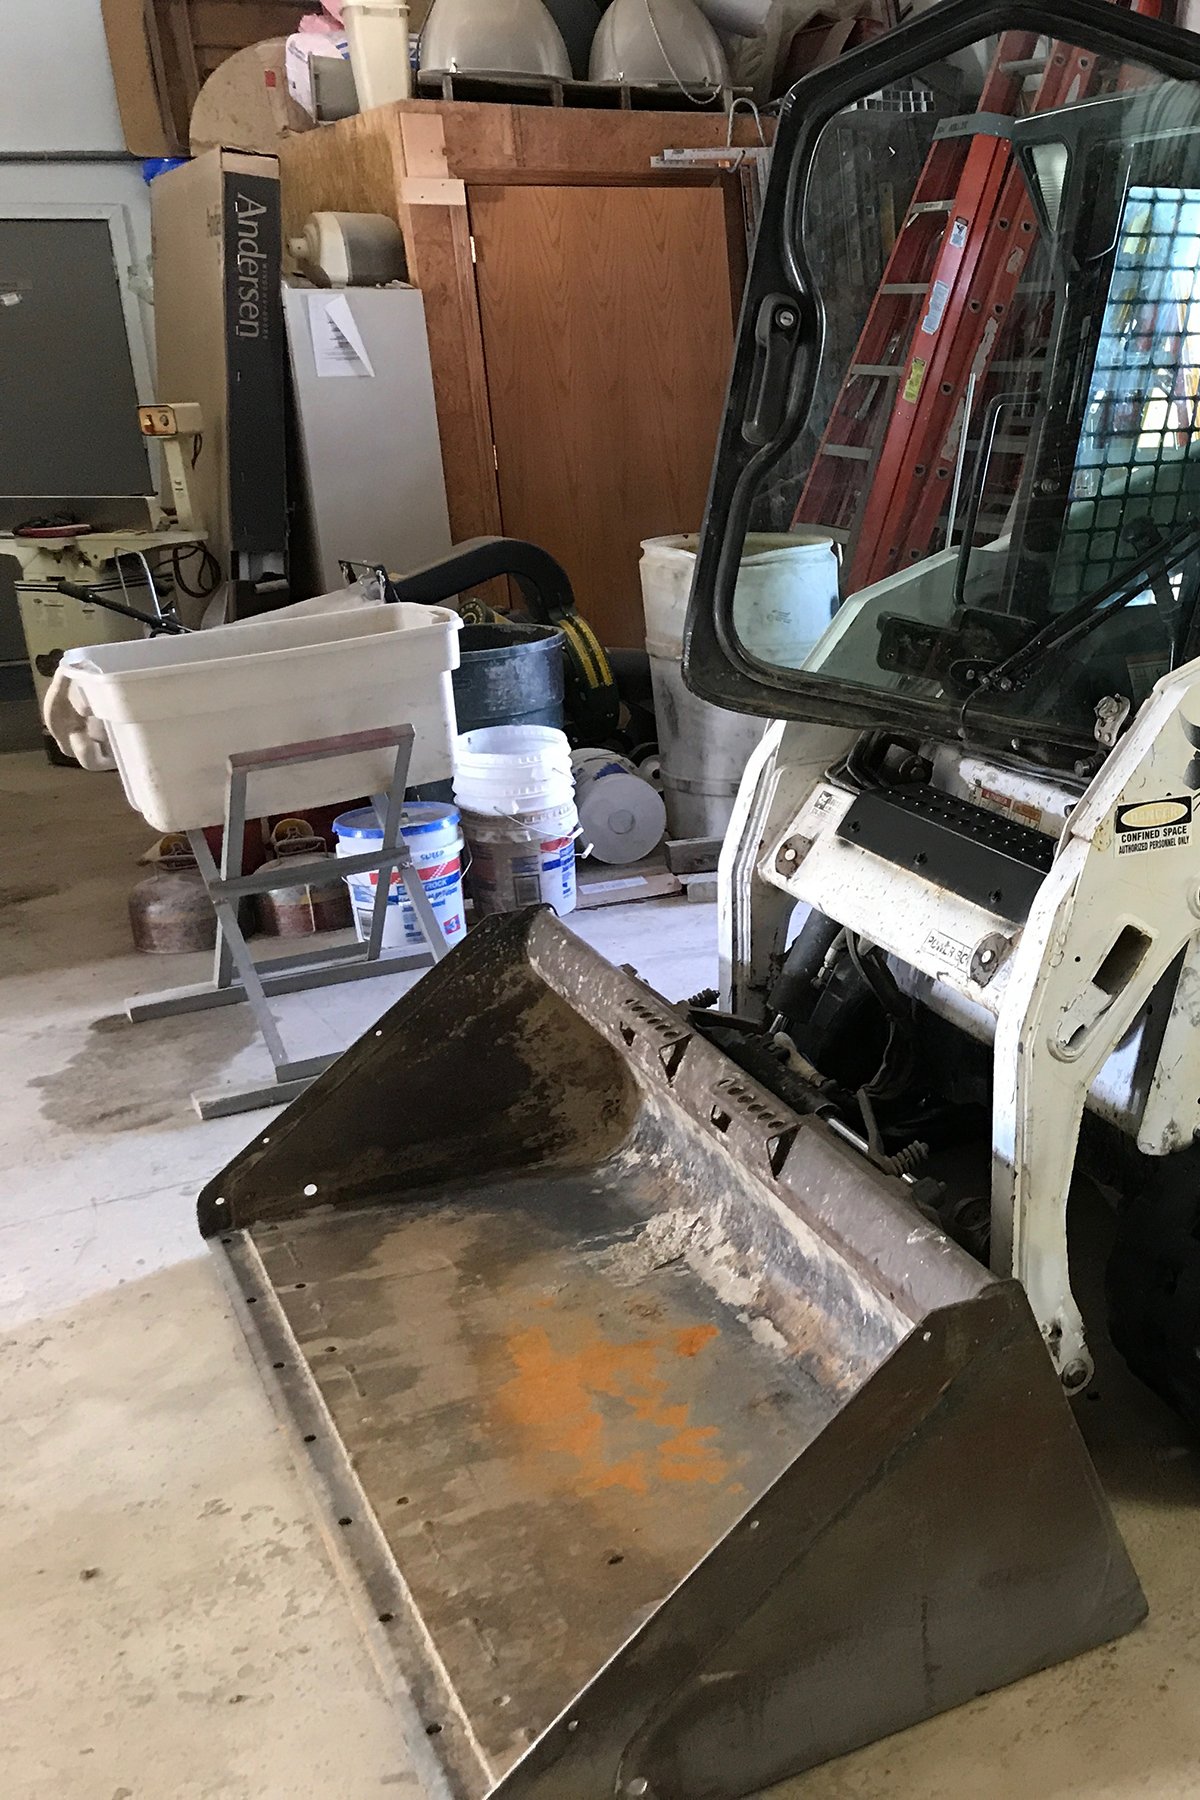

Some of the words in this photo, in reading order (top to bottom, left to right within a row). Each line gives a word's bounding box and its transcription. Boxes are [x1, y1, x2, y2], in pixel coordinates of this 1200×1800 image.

[237, 192, 267, 338] Andersen
[1121, 829, 1160, 843] CONFINED
[1163, 825, 1187, 837] SPACE
[1119, 842, 1149, 855] AUTHORIZED
[1149, 838, 1176, 850] PERSONNEL
[1178, 835, 1190, 845] ONLY
